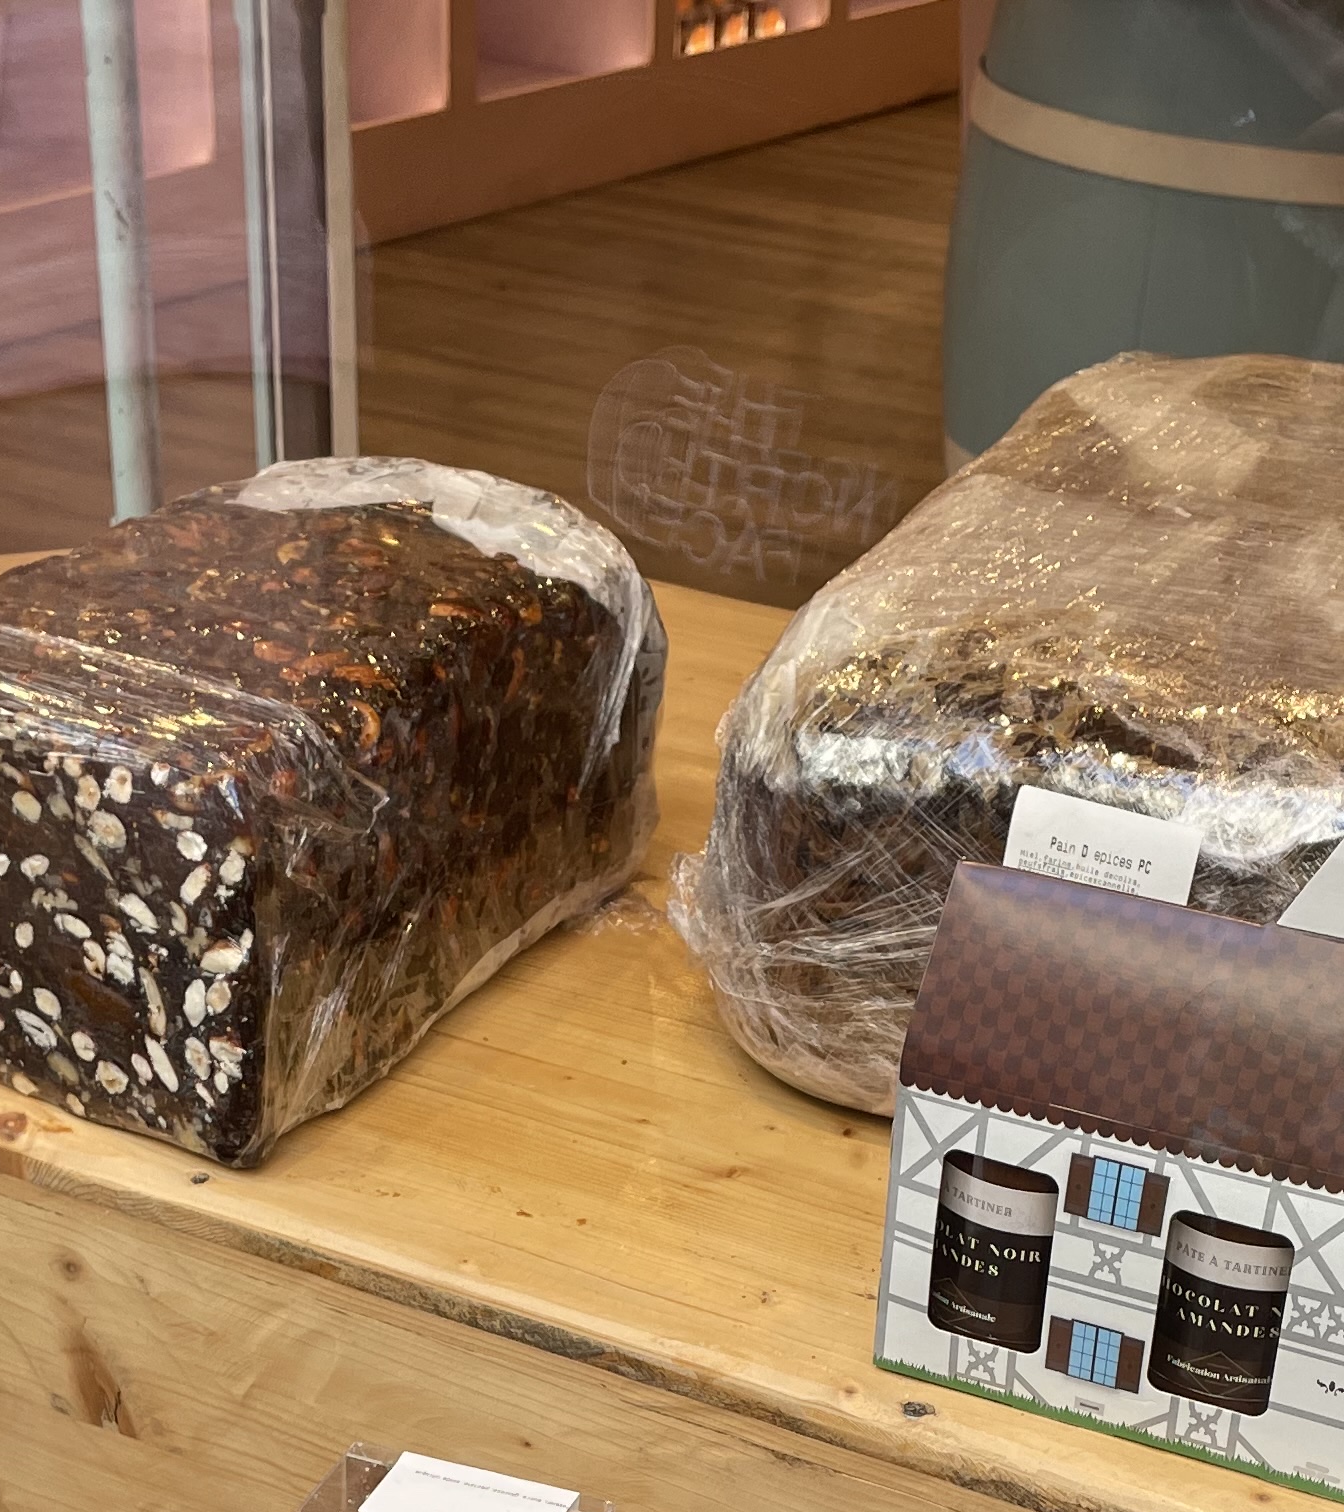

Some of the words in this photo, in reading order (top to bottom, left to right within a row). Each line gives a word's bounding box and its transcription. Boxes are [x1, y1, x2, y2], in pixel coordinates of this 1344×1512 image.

[1050, 836, 1077, 856] Pain
[1081, 844, 1090, 858] D
[1093, 850, 1134, 870] epices
[1138, 858, 1153, 876] PC
[953, 1189, 1014, 1218] TARTINER
[989, 1242, 1042, 1264] NOIR
[1176, 1307, 1281, 1339] AMANDES
